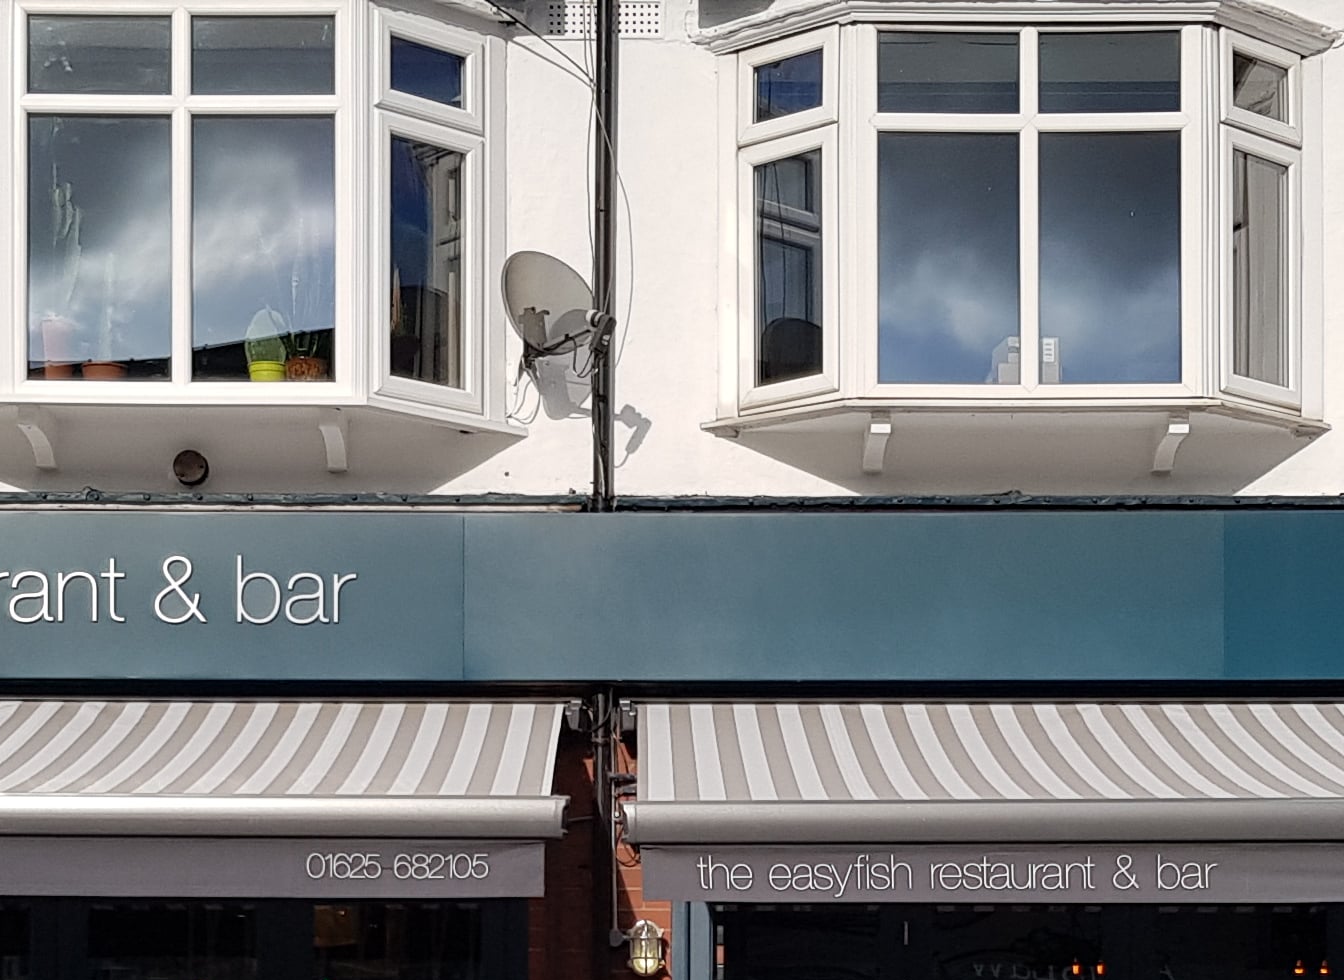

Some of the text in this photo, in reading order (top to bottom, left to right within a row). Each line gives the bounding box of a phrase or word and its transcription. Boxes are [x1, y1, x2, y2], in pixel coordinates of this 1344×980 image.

[154, 555, 207, 624] &
[236, 554, 357, 625] bar
[306, 852, 490, 881] 01625 682105
[696, 853, 1218, 898] the easyfish restaurant & bar
